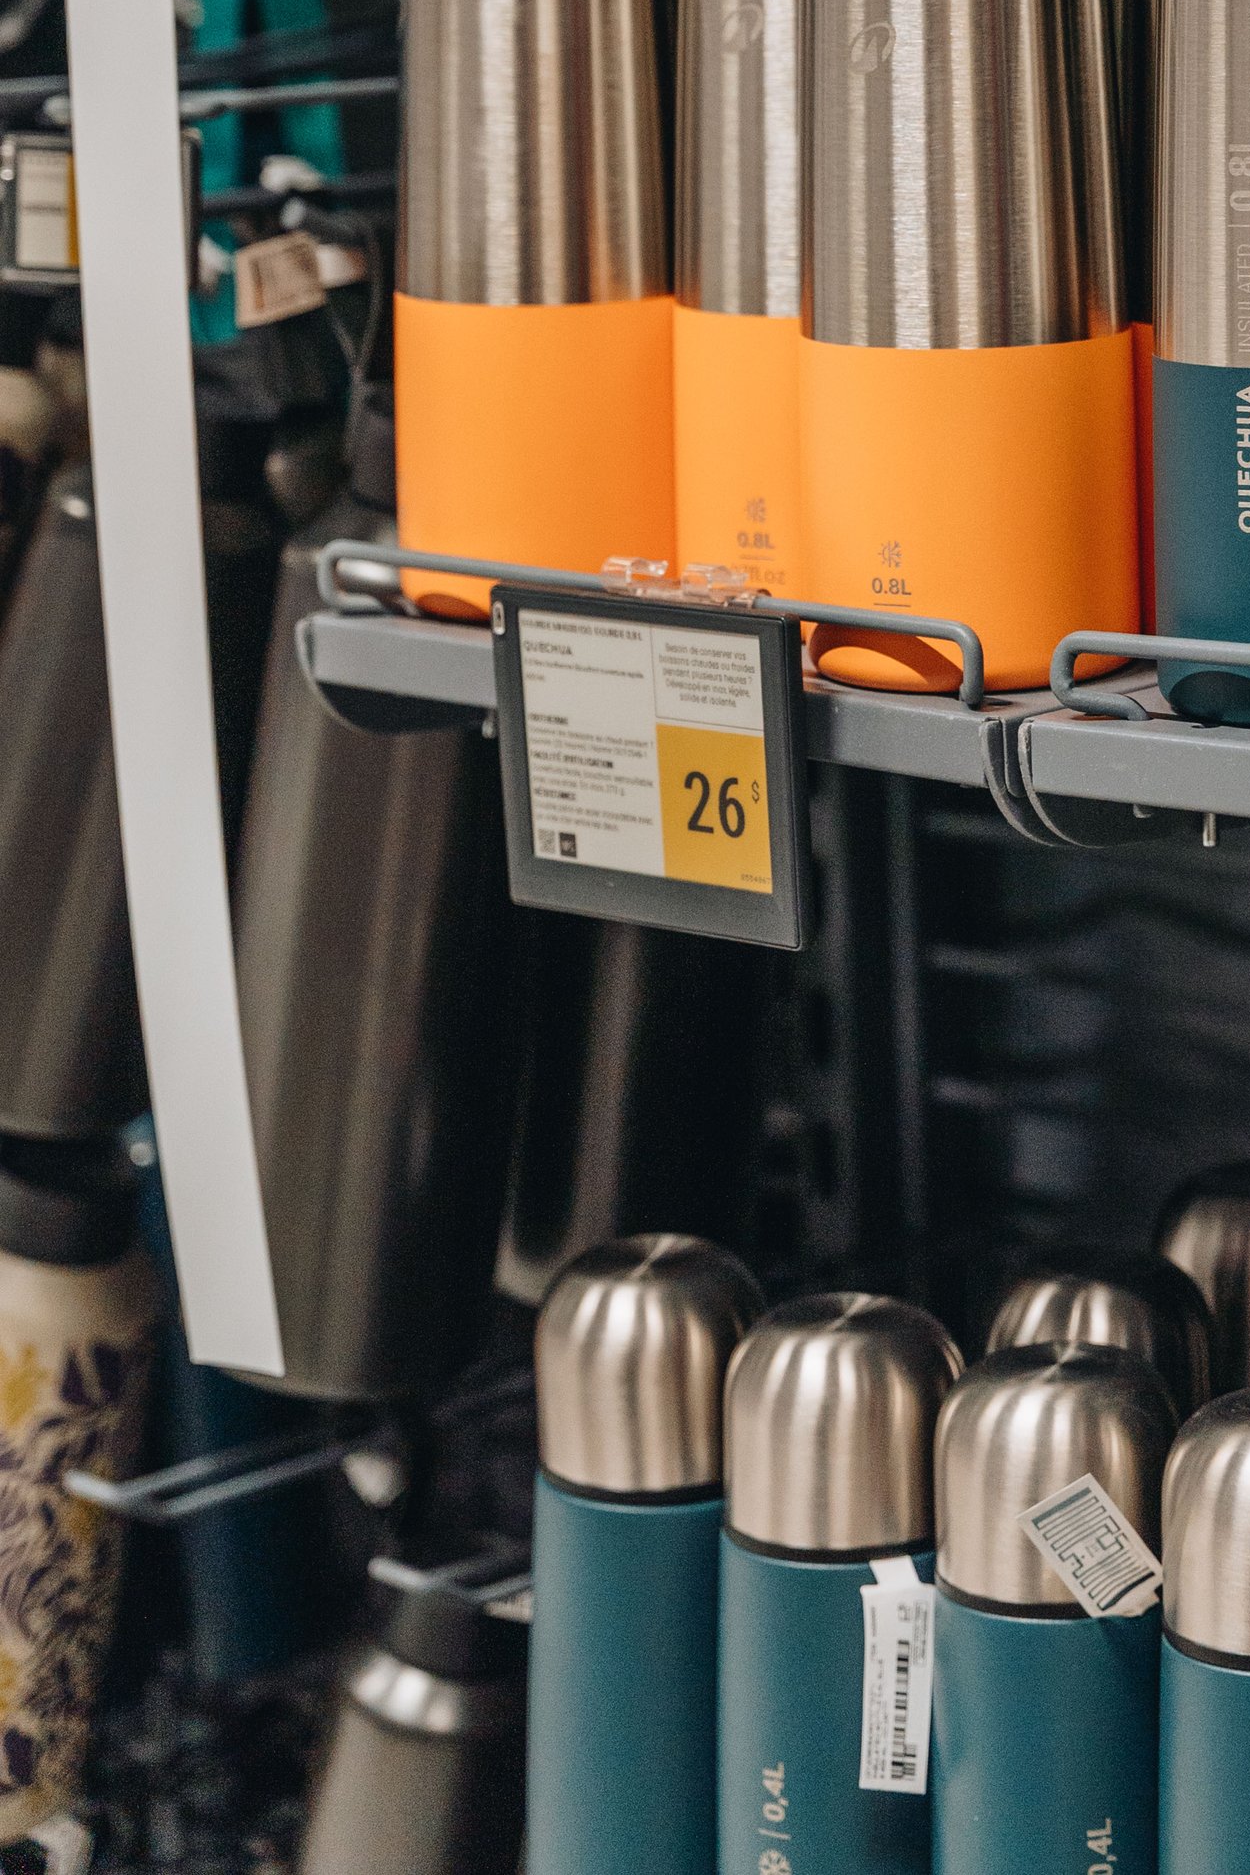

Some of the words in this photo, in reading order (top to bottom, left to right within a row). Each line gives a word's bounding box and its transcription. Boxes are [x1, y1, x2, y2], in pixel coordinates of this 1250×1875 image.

[736, 531, 776, 550] 0.8L
[871, 577, 912, 596] 0.8L
[690, 657, 719, 669] chaudes
[682, 769, 746, 839] 26
[750, 779, 760, 804] $
[761, 1761, 786, 1822] 0,4L
